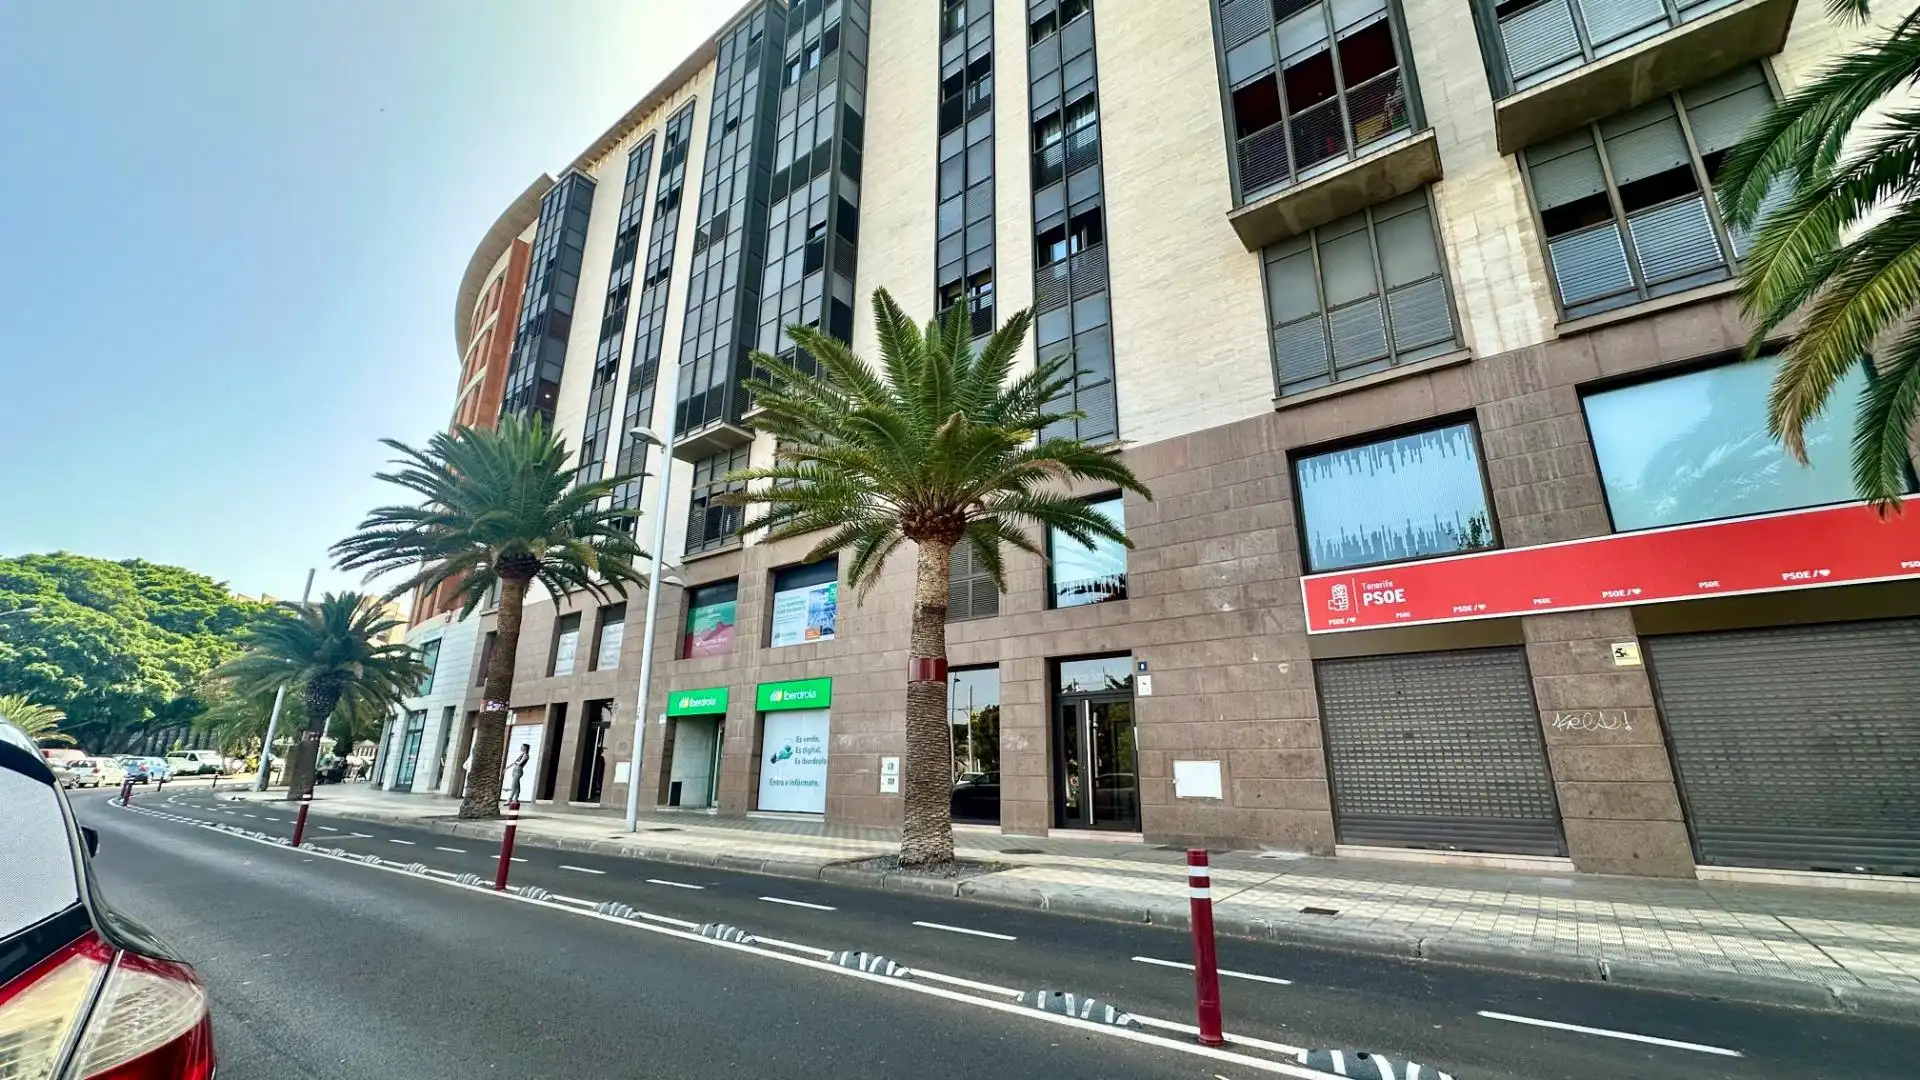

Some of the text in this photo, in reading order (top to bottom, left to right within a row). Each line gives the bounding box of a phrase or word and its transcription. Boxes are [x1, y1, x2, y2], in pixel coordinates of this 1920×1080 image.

[1901, 561, 1920, 569] PSO
[1782, 570, 1811, 581] PSOE
[1361, 580, 1394, 590] Tenerife
[1698, 580, 1720, 589] PSOE
[1363, 588, 1406, 607] PSOE
[1602, 589, 1625, 599] PSOE
[1533, 597, 1551, 605] PSOE
[1453, 605, 1473, 613] PSOE
[1328, 618, 1345, 626] PSOE
[783, 688, 817, 701] Iberdrola
[690, 697, 717, 708] Iberdrola
